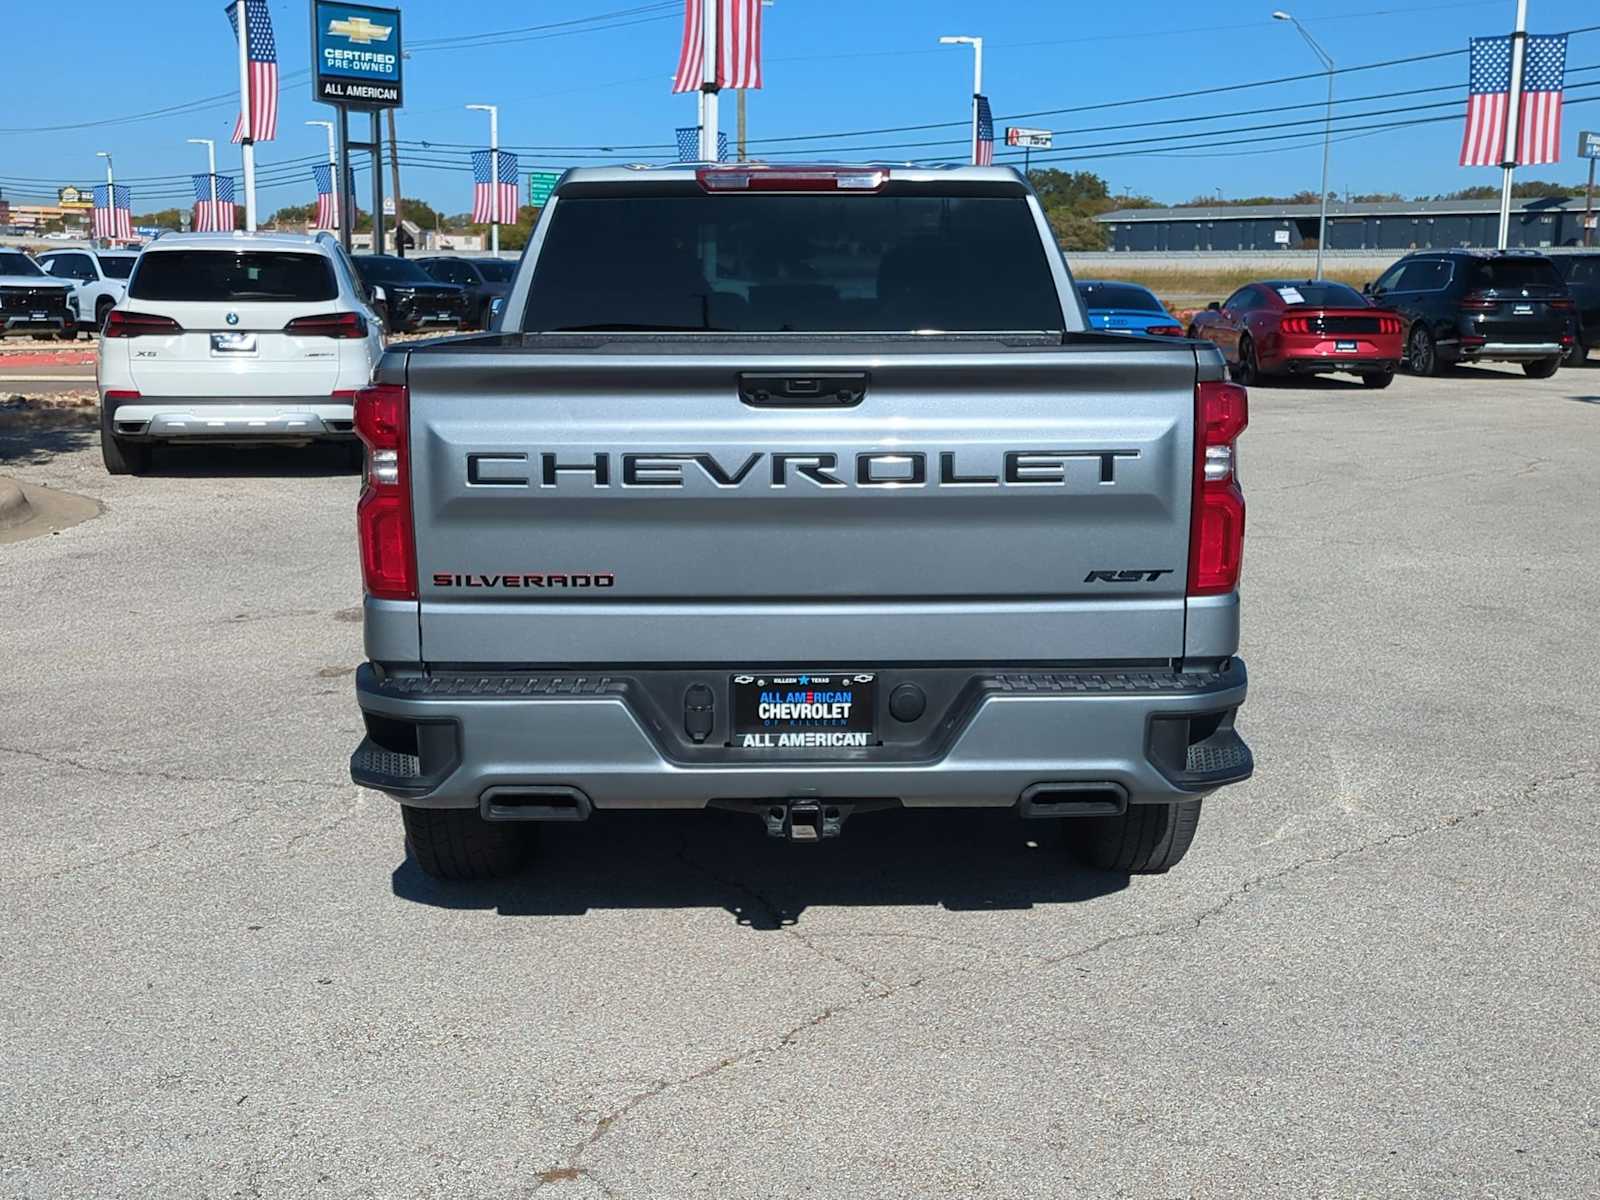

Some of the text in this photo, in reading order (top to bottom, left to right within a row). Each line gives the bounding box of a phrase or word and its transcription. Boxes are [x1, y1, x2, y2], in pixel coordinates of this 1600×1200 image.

[324, 48, 395, 64] CERTIFIED
[328, 58, 393, 73] PRE-OWNED
[324, 83, 397, 100] ALL AMERICAN
[465, 449, 1141, 488] CHEVROLET
[433, 573, 615, 588] SILVERADO
[1083, 569, 1175, 583] RST
[759, 691, 852, 704] ALL AMERICAN
[758, 703, 852, 719] CHEVROLET
[743, 732, 867, 747] ALL AMERICAN
